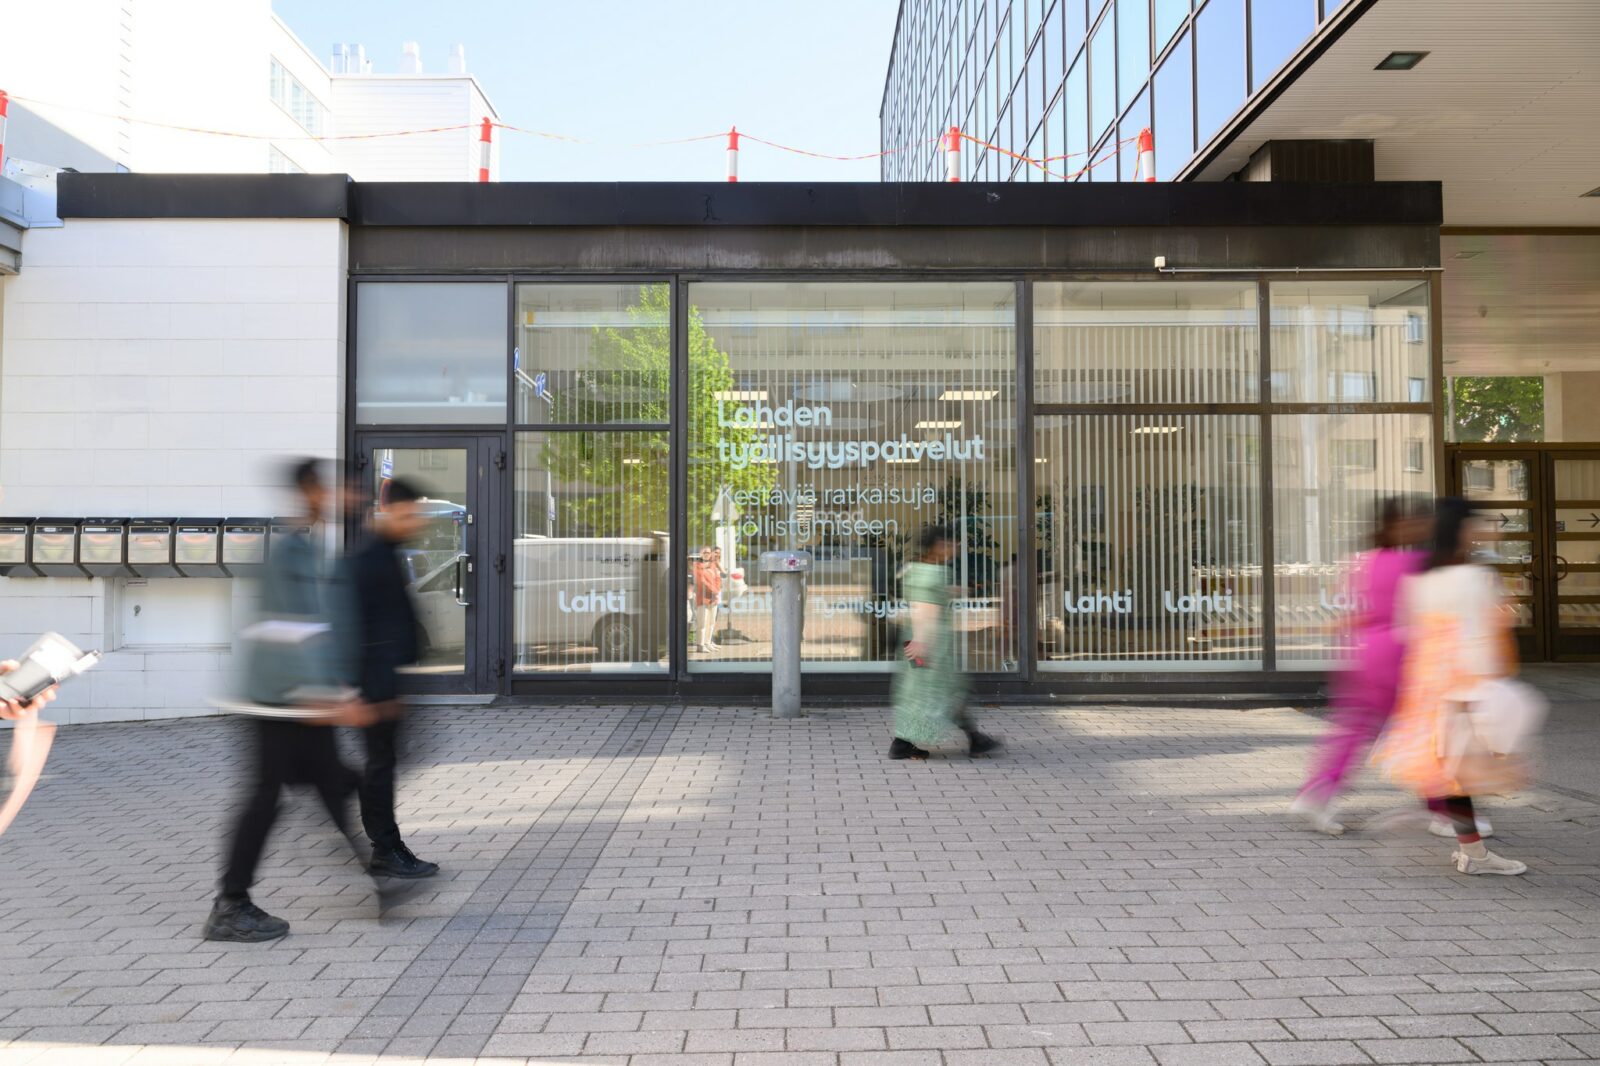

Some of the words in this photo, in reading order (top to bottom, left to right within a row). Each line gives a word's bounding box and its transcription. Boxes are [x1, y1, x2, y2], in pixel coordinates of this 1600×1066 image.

[718, 399, 832, 427] Lahden
[718, 433, 984, 469] työllisyyspalvelut
[719, 483, 817, 506] Kestäviä
[824, 482, 937, 510] ratkaisuja
[559, 588, 626, 613] Lahti
[1064, 588, 1133, 614] Lahti
[1164, 588, 1233, 614] Lahti
